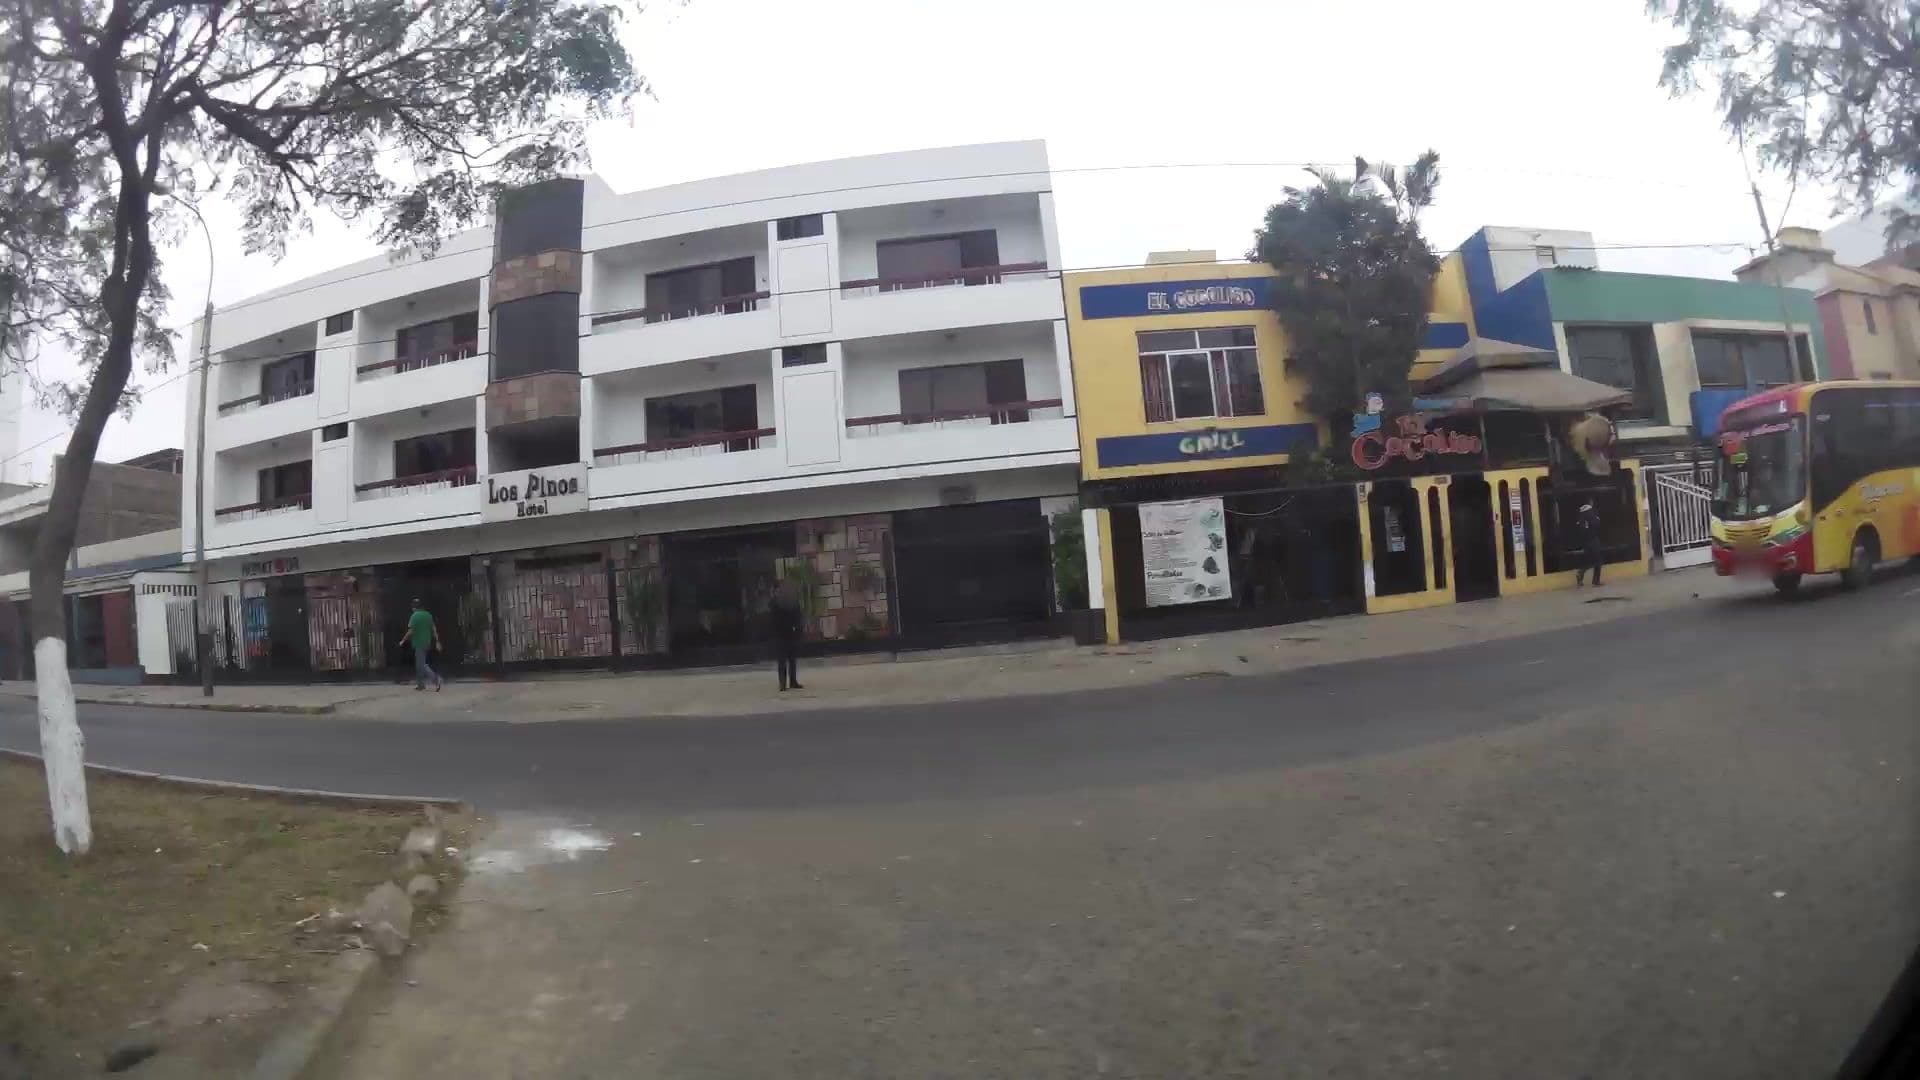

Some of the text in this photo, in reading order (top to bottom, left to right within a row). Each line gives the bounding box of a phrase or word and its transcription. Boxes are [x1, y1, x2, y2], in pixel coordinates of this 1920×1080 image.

[1147, 290, 1171, 310] EL
[487, 471, 579, 505] Los Pinos
[515, 499, 549, 518] Hotel
